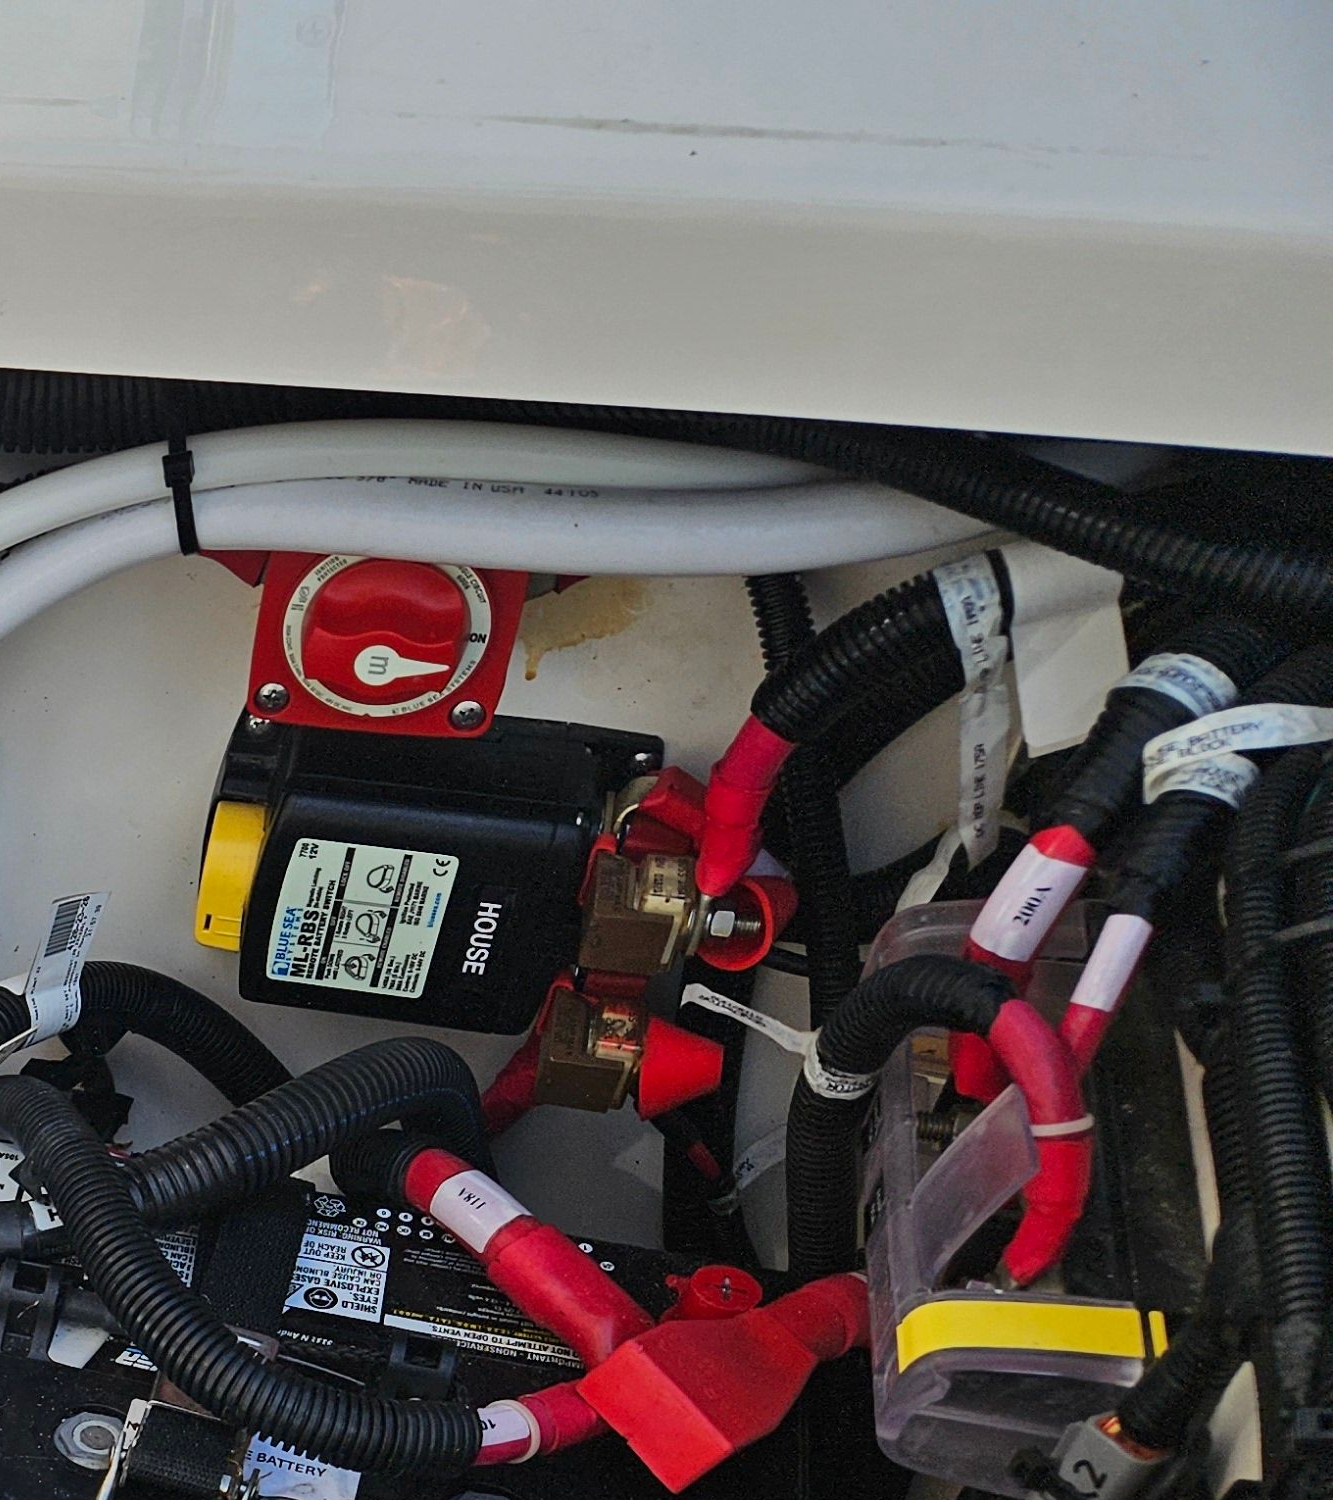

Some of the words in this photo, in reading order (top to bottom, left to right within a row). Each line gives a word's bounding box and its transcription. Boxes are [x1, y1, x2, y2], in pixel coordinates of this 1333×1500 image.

[469, 633, 486, 643] ON
[298, 841, 309, 858] 7700
[308, 842, 320, 860] 12V
[281, 904, 298, 930] SEA
[306, 947, 320, 979] REMOTE
[313, 911, 328, 946] BATTERY
[322, 878, 336, 910] SWITCH
[274, 930, 292, 960] BLUE
[288, 908, 321, 978] ML-RBS
[460, 900, 504, 977] HOUSE
[302, 1246, 323, 1257] OUT
[318, 1241, 346, 1253] REACH
[324, 1249, 345, 1261] KEEP
[331, 1263, 367, 1277] INJURY.
[331, 1269, 360, 1283] CAUSE
[322, 1276, 380, 1296] EXPLOSIVE
[340, 1298, 378, 1313] SHIELD
[348, 1291, 379, 1304] EYES.
[427, 1323, 462, 1337] VENTS.
[463, 1329, 489, 1341] OPEN
[503, 1335, 549, 1353] ATTEMPT
[256, 1451, 326, 1478] BATTERY
